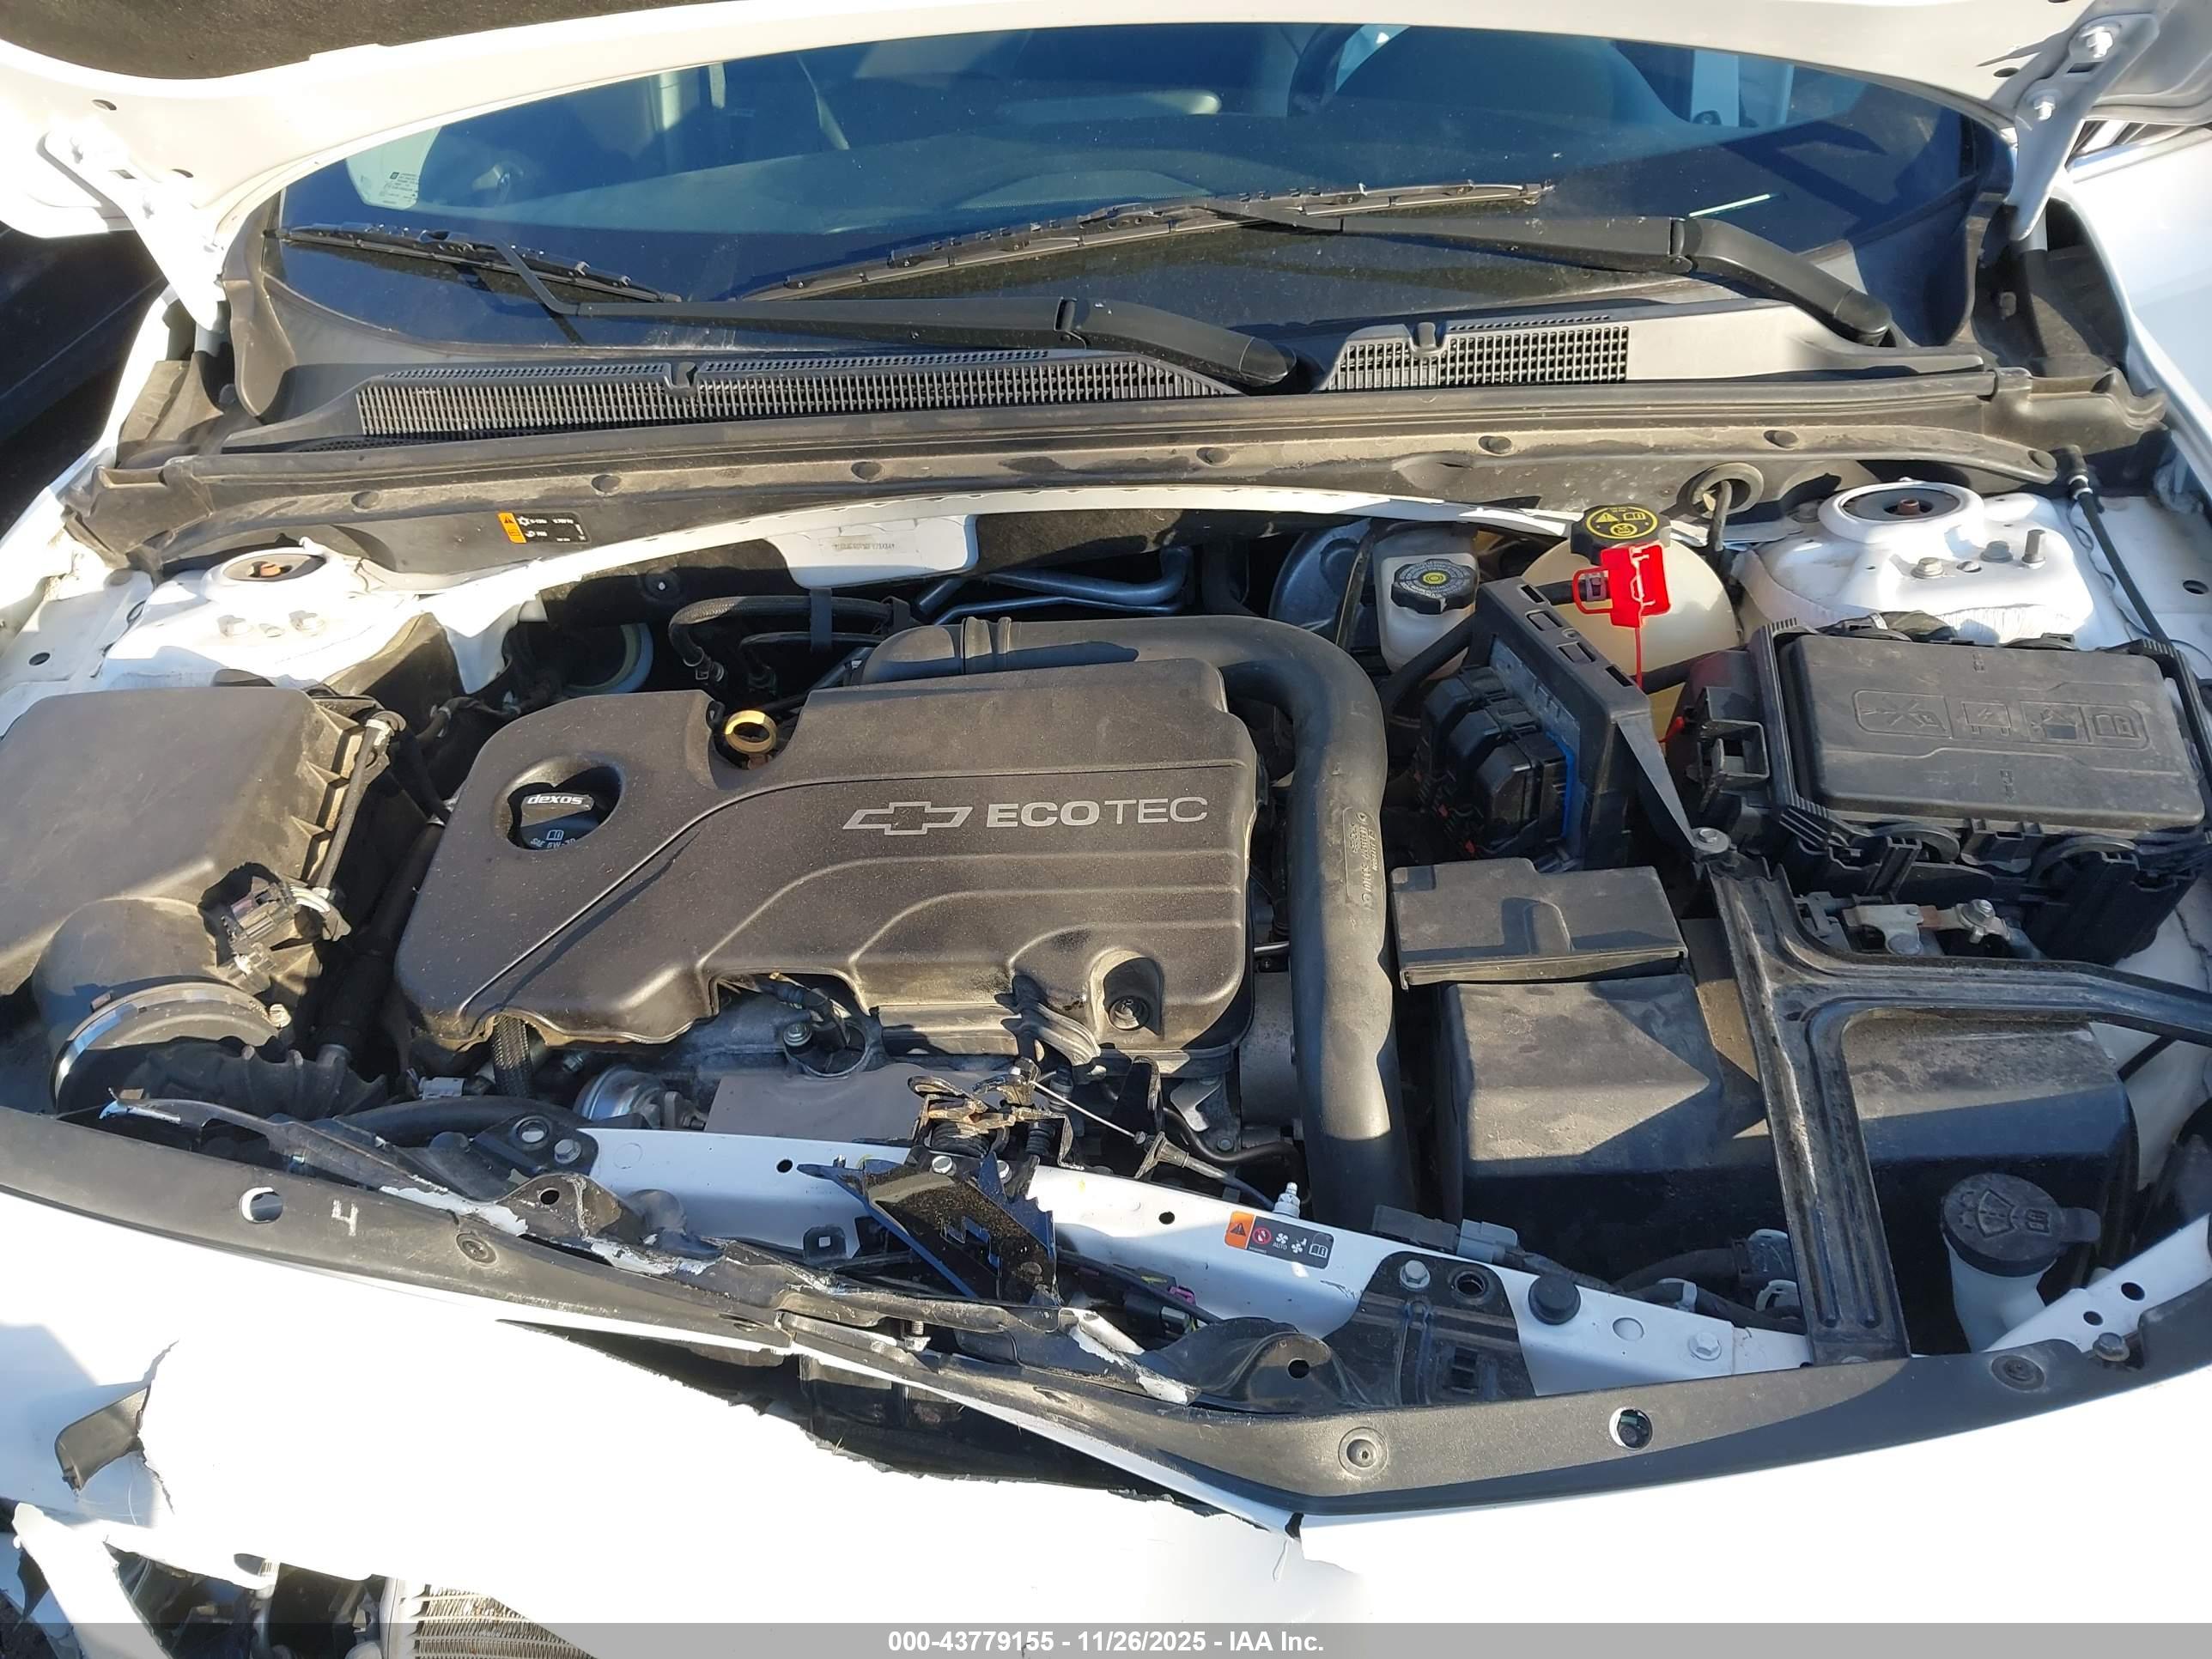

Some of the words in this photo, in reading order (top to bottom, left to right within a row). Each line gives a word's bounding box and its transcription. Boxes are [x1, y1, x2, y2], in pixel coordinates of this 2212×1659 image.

[527, 793, 584, 805] dexos
[987, 796, 1208, 827] ECOTEC
[331, 1199, 359, 1237] 4
[1273, 1242, 1287, 1251] AUTO
